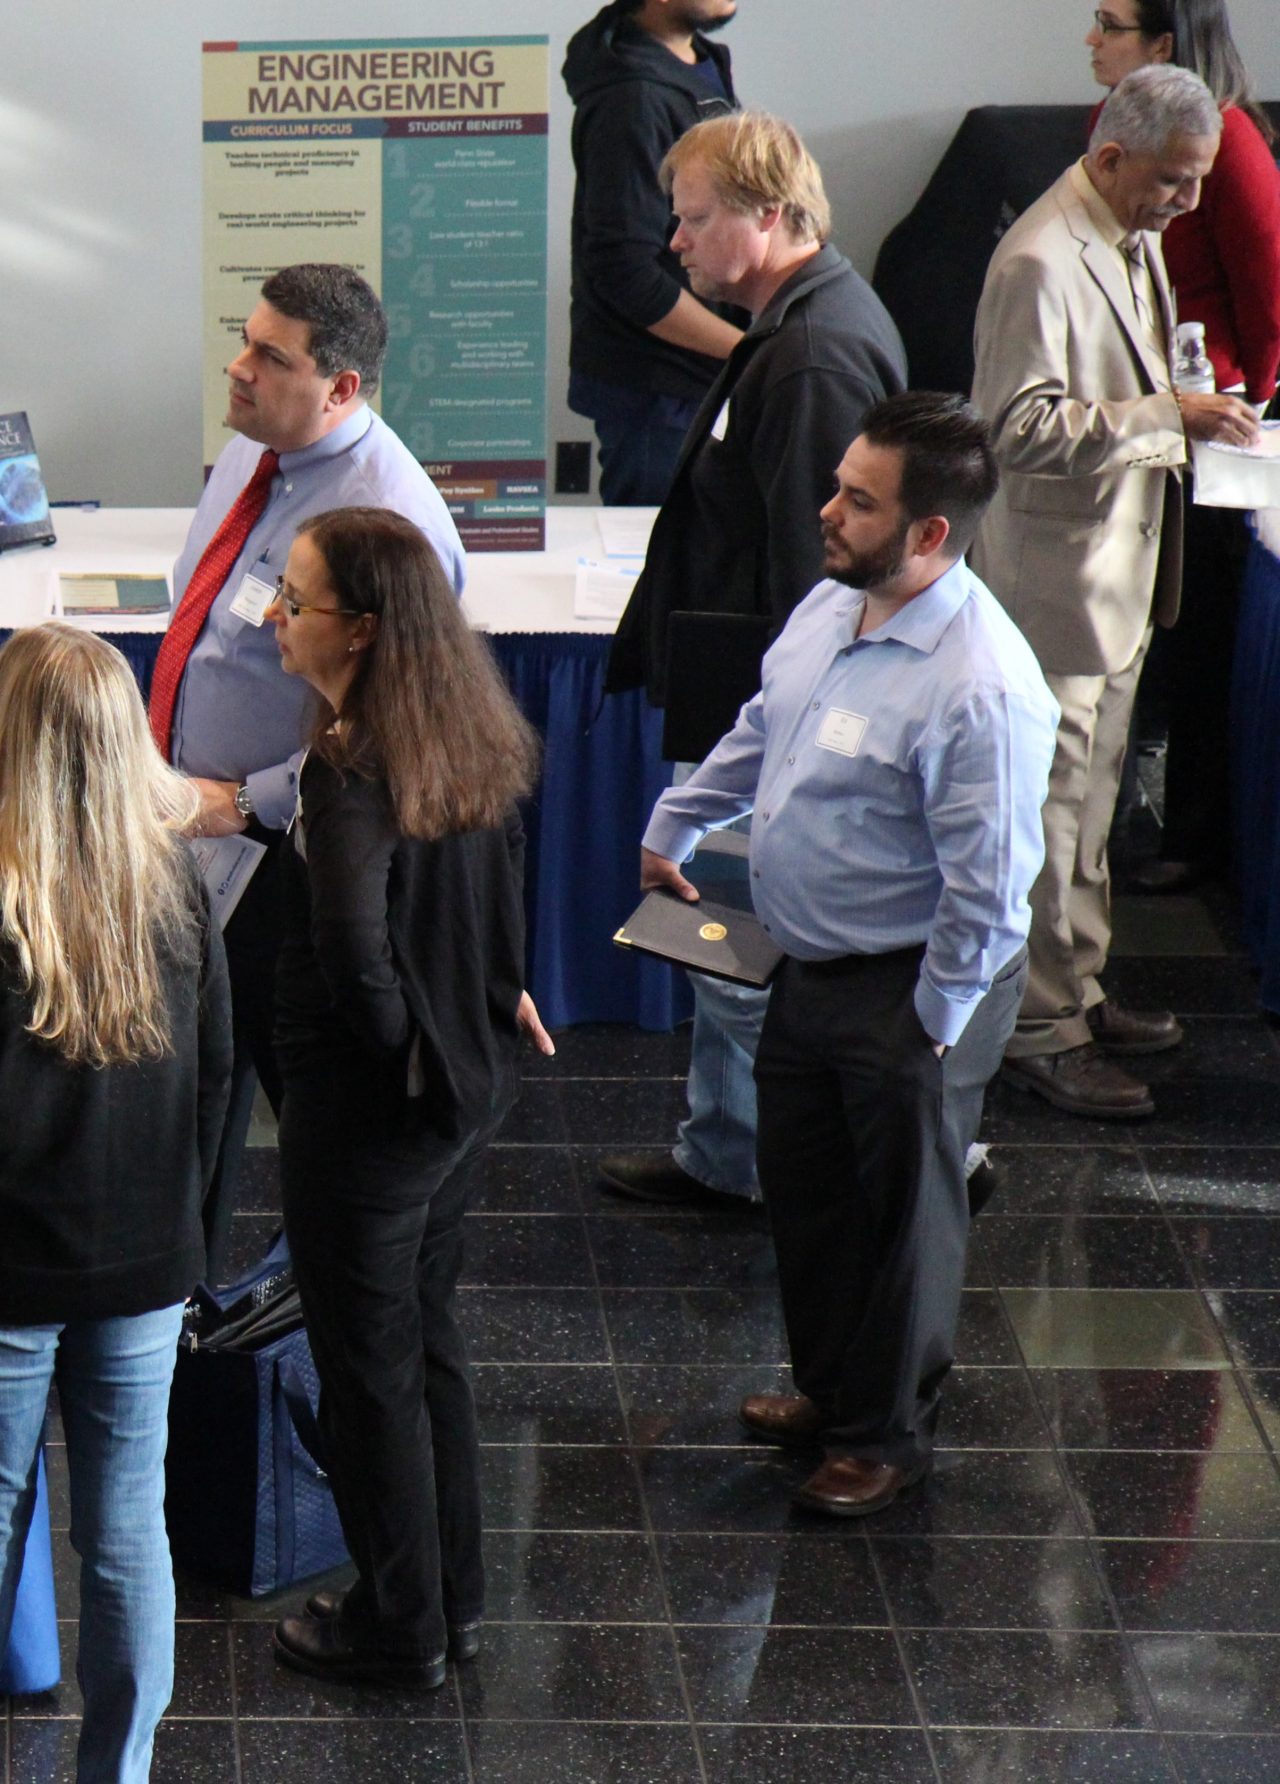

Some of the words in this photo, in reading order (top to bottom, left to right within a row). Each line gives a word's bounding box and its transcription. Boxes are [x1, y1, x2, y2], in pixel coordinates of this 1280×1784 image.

[257, 50, 495, 82] ENGINEERING
[247, 81, 506, 114] MANAGEMENT
[230, 124, 309, 137] CURRICULUM
[311, 123, 353, 136] FOCUS
[407, 121, 463, 133] STUDENT
[466, 119, 523, 132] BENEFITS
[261, 151, 300, 159] technical
[263, 161, 291, 169] people
[293, 160, 310, 168] and
[311, 159, 355, 168] managing
[274, 168, 310, 178] projects
[409, 182, 436, 219] 2
[315, 210, 353, 220] thinking
[324, 219, 358, 228] projects
[387, 224, 413, 259] 3
